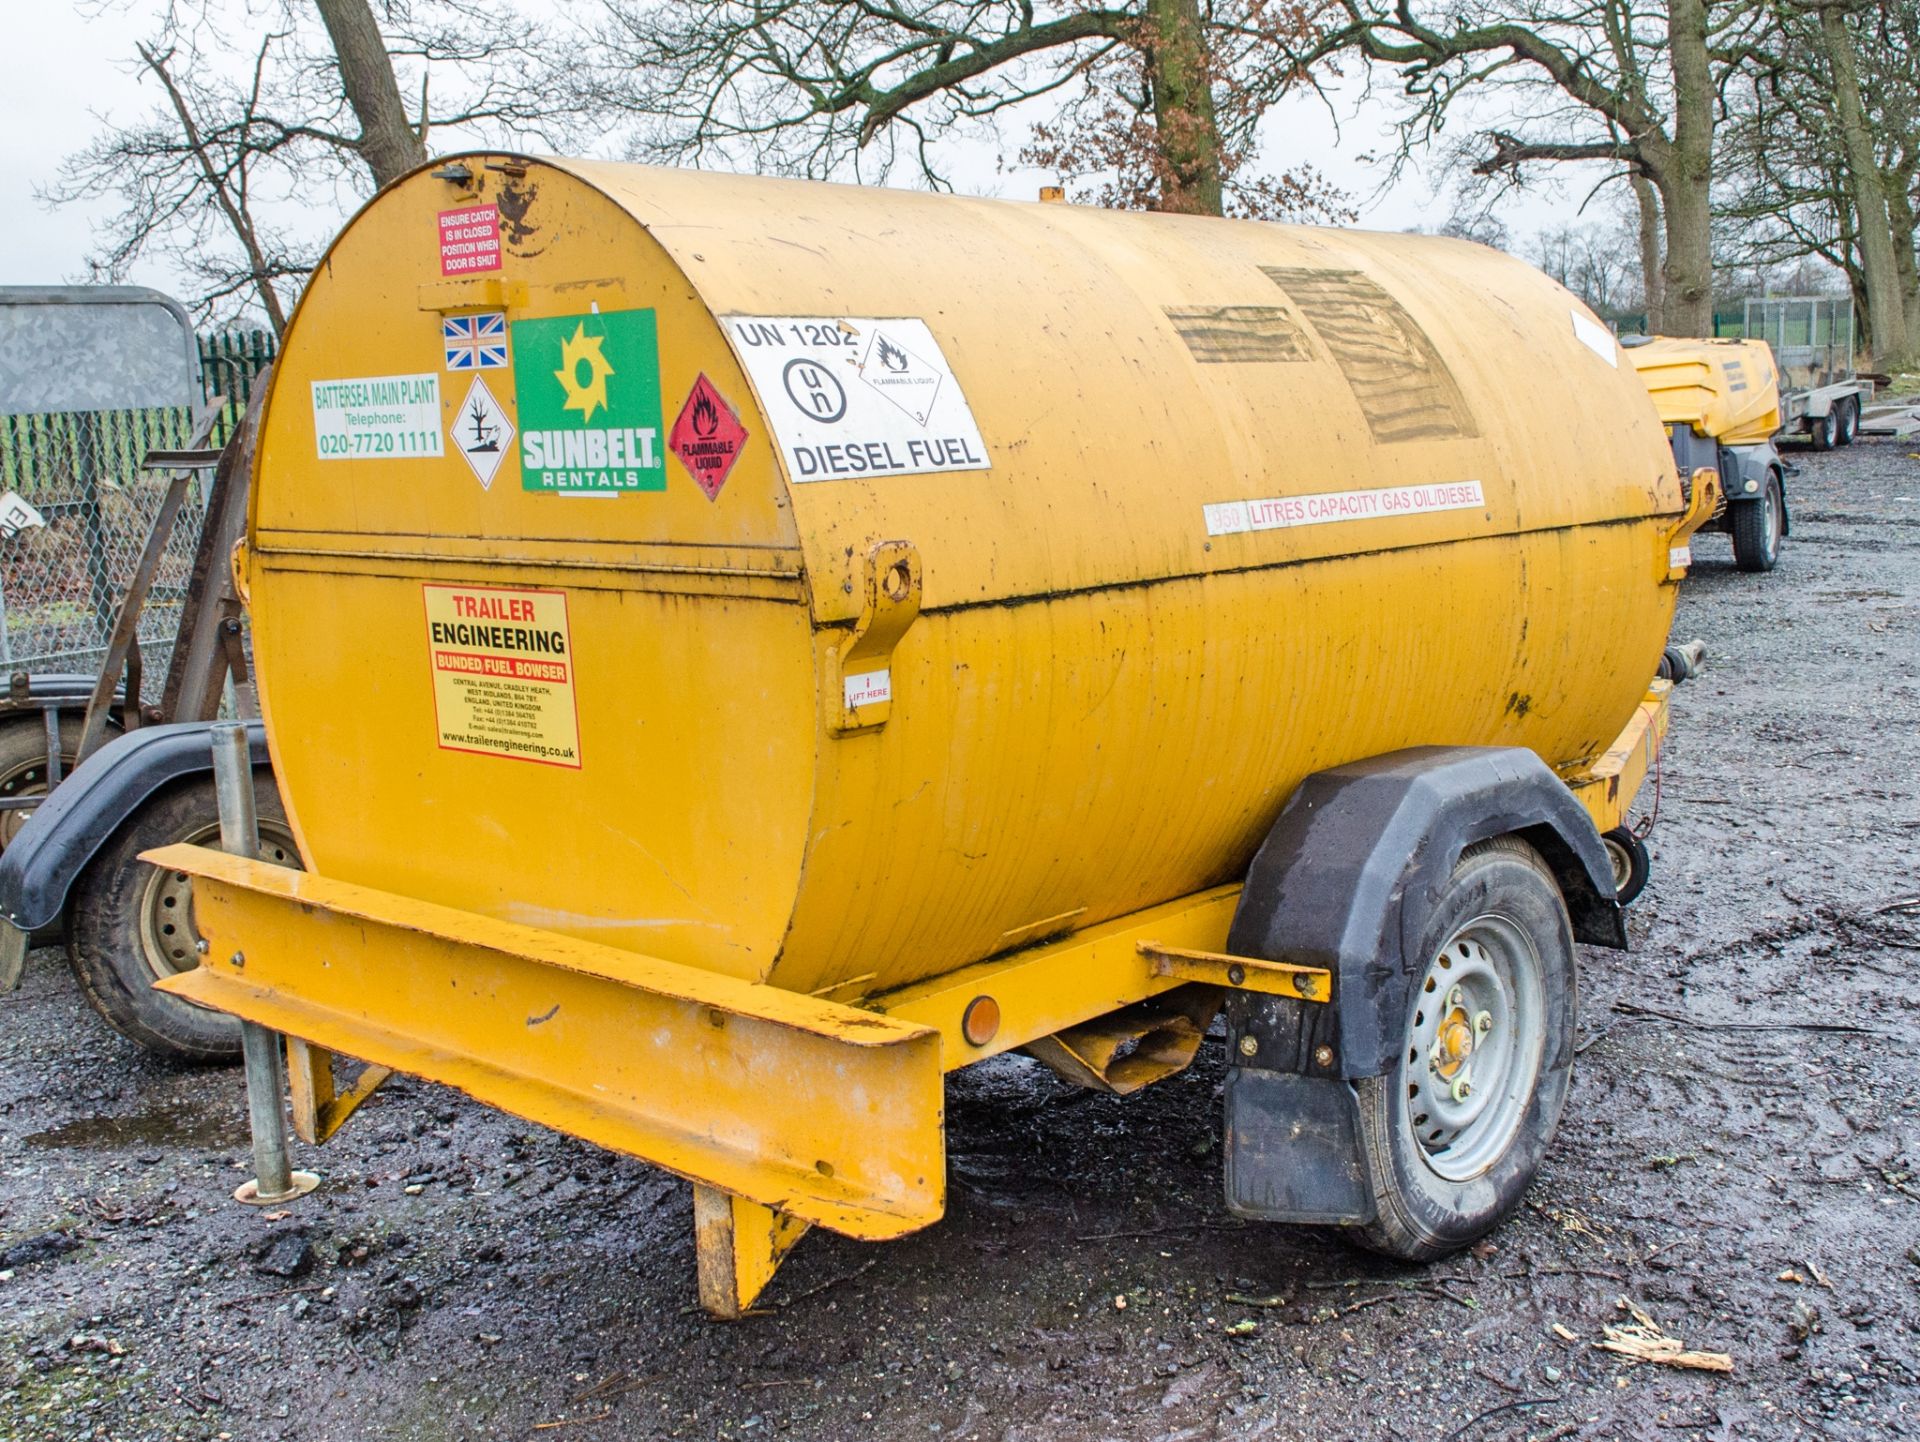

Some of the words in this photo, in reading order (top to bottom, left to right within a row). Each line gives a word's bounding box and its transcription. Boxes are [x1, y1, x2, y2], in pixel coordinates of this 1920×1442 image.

[440, 213, 470, 227] ENSURE
[471, 210, 496, 223] CATCH
[446, 230, 453, 241] IS
[454, 229, 462, 240] IN
[463, 225, 492, 238] CLOSED
[442, 242, 475, 256] POSITION
[476, 239, 498, 252] WHEN
[446, 258, 468, 270] DOOR
[468, 257, 476, 267] IS
[477, 254, 496, 266] SHUT
[736, 324, 785, 346] UN
[790, 324, 859, 346] 1202
[315, 383, 370, 409] BATTERSEA
[371, 381, 399, 406] MAIN
[401, 379, 434, 404] PLANT
[345, 412, 406, 427] Telephone:
[916, 411, 924, 421] 3
[320, 432, 394, 453] 020-7720
[399, 431, 437, 451] 1111
[522, 428, 657, 469] SUNBELT
[682, 441, 733, 456] FLAMMABLE
[696, 457, 722, 470] LIQUID
[793, 442, 905, 476] DIESEL
[907, 438, 981, 467] FUEL
[543, 471, 638, 487] RENTALS
[706, 475, 714, 487] 3
[1250, 501, 1305, 524] LITRES
[1308, 493, 1377, 518] CAPACITY
[1382, 491, 1411, 510] GAS
[1413, 486, 1481, 508] OIL/DIESEL
[453, 595, 536, 622] TRAILER
[432, 622, 565, 654] ENGINEERING
[437, 654, 482, 672] BUNDED
[484, 658, 514, 675] FUEL
[516, 661, 566, 680] BOWSER
[453, 678, 477, 687] CENTRAL
[503, 683, 529, 692] CRADLEY
[467, 688, 481, 696] WEST
[464, 696, 491, 706] ENGLAND,
[492, 700, 513, 708] UNITED
[849, 692, 865, 703] LIFT
[867, 688, 888, 698] HERE
[443, 732, 575, 758] www.trailerengineering.co.uk
